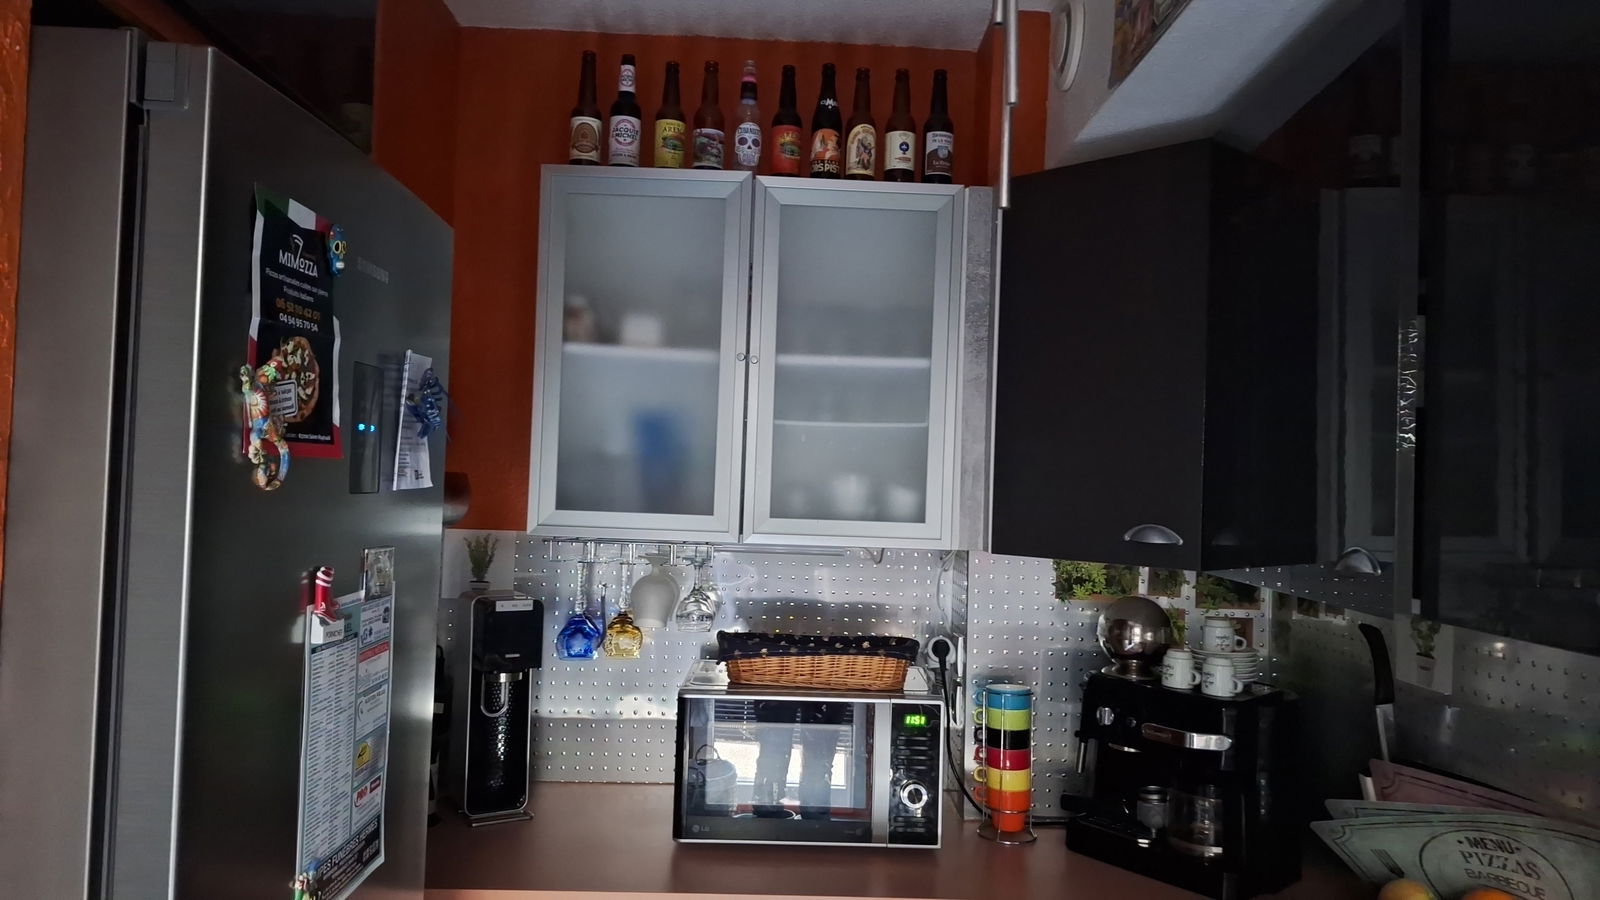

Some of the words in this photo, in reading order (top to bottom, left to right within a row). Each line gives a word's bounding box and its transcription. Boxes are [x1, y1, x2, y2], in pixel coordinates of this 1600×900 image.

[279, 313, 287, 323] 04
[1464, 836, 1514, 855] MENU
[1458, 849, 1542, 881] PIZZAS
[1463, 868, 1548, 900] BARBECUE
